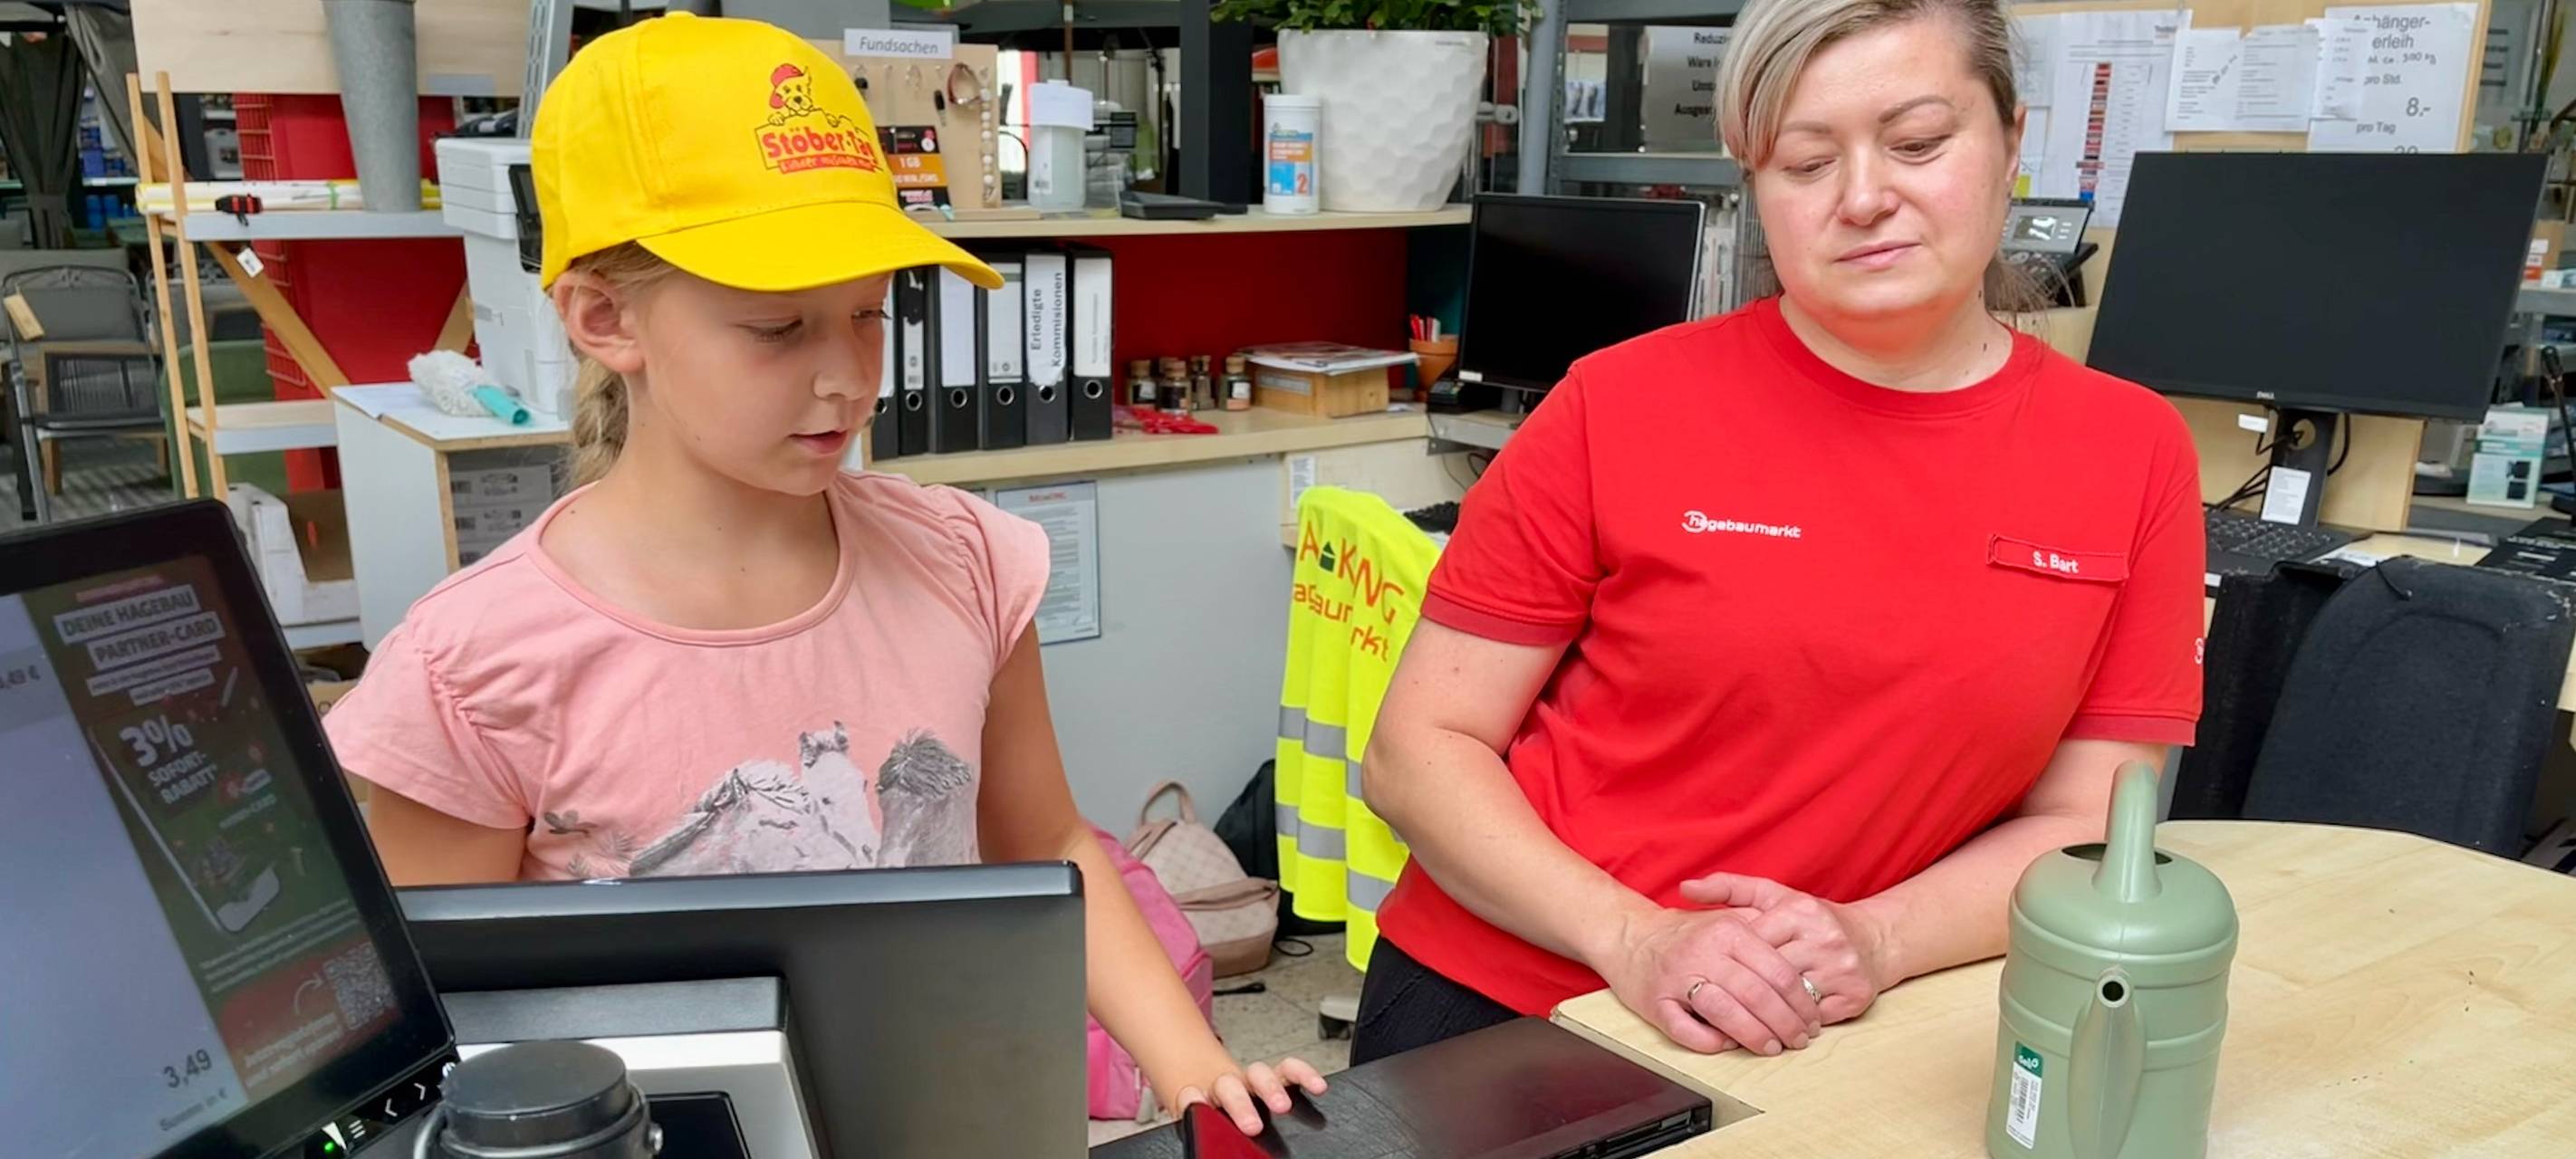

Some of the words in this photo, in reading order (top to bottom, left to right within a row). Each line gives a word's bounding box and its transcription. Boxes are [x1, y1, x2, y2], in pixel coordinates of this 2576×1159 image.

[2354, 14, 2431, 32] hänger-
[859, 36, 939, 54] Fundsachen
[2371, 34, 2414, 49] erleih
[2357, 123, 2374, 134] pro
[2377, 121, 2397, 135] Tag
[1296, 173, 1309, 194] 2
[1031, 288, 1043, 351] Erledigte
[1051, 272, 1063, 368] Kommisionen
[1681, 510, 1802, 538] hagebaumarkt
[2033, 551, 2047, 568] S.
[2049, 553, 2079, 574] Bart
[62, 610, 116, 637] DEINE
[116, 592, 194, 627] HAGEBAU
[94, 617, 219, 663] PARTNER-CARD
[119, 714, 194, 767] 3%
[148, 751, 208, 788] SOFORT-
[162, 1049, 212, 1089] 3,49
